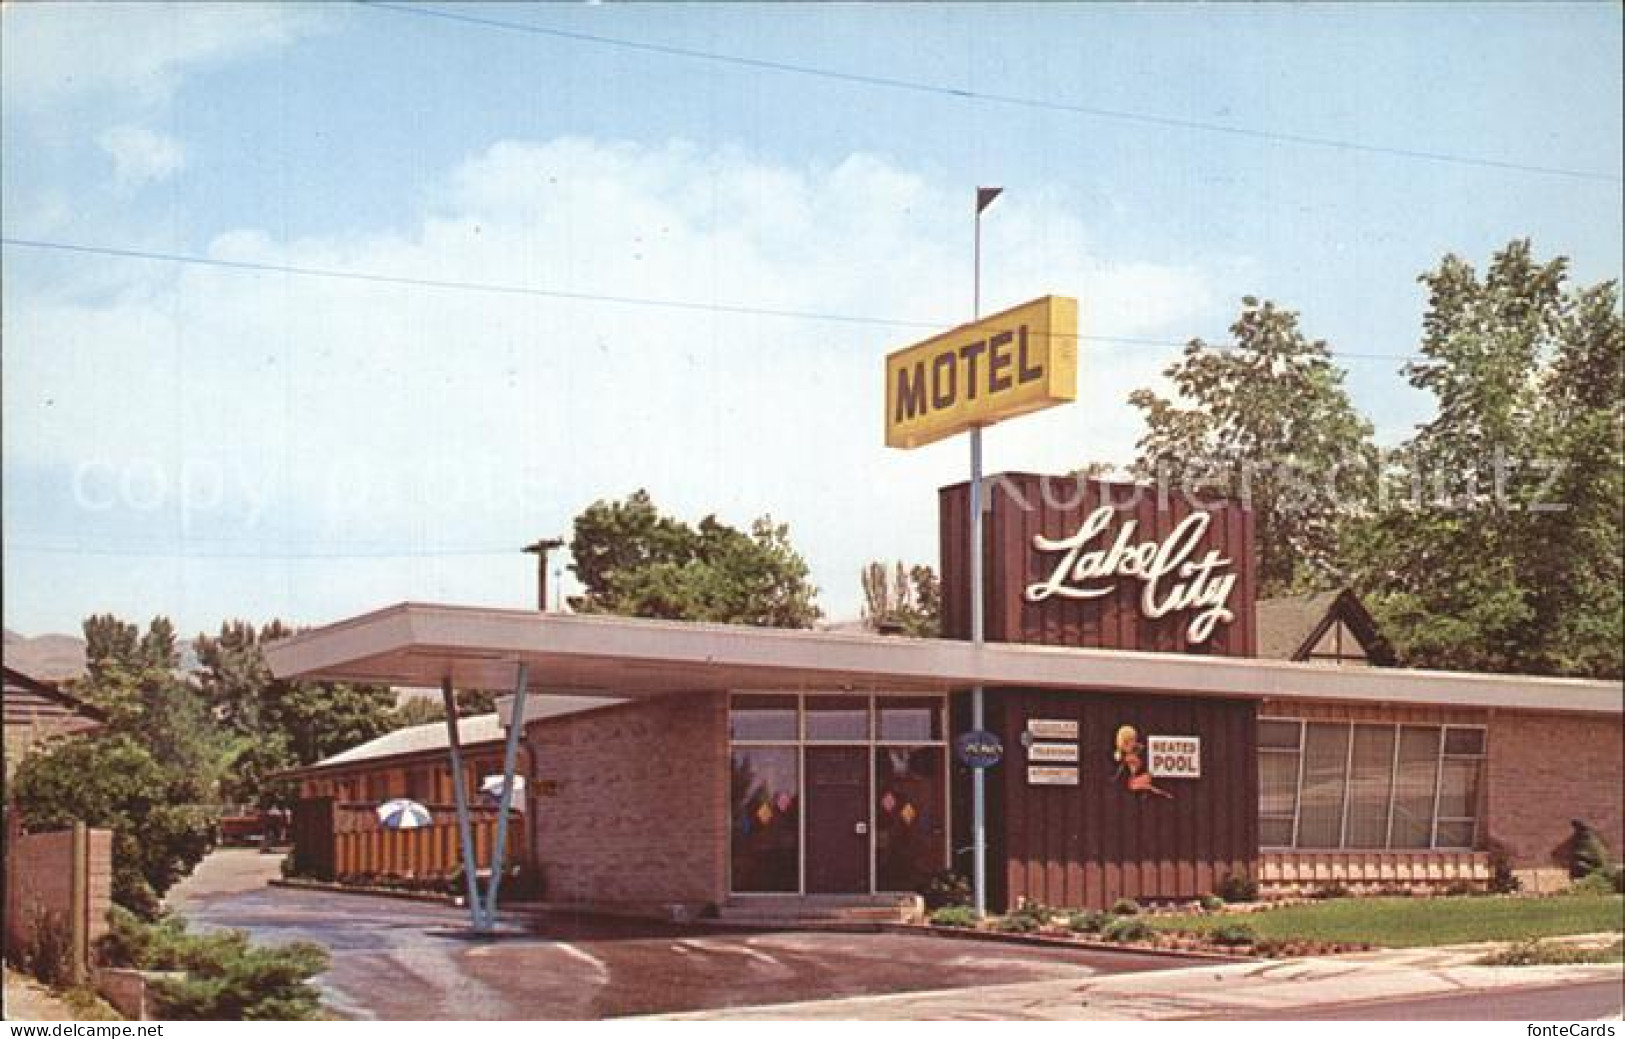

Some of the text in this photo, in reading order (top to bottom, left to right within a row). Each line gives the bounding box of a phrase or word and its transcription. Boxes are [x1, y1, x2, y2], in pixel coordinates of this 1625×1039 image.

[895, 324, 1043, 423] MOTEL
[1025, 505, 1238, 643] Lake City
[1152, 741, 1197, 754] HEATED
[1152, 754, 1198, 774] POOL
